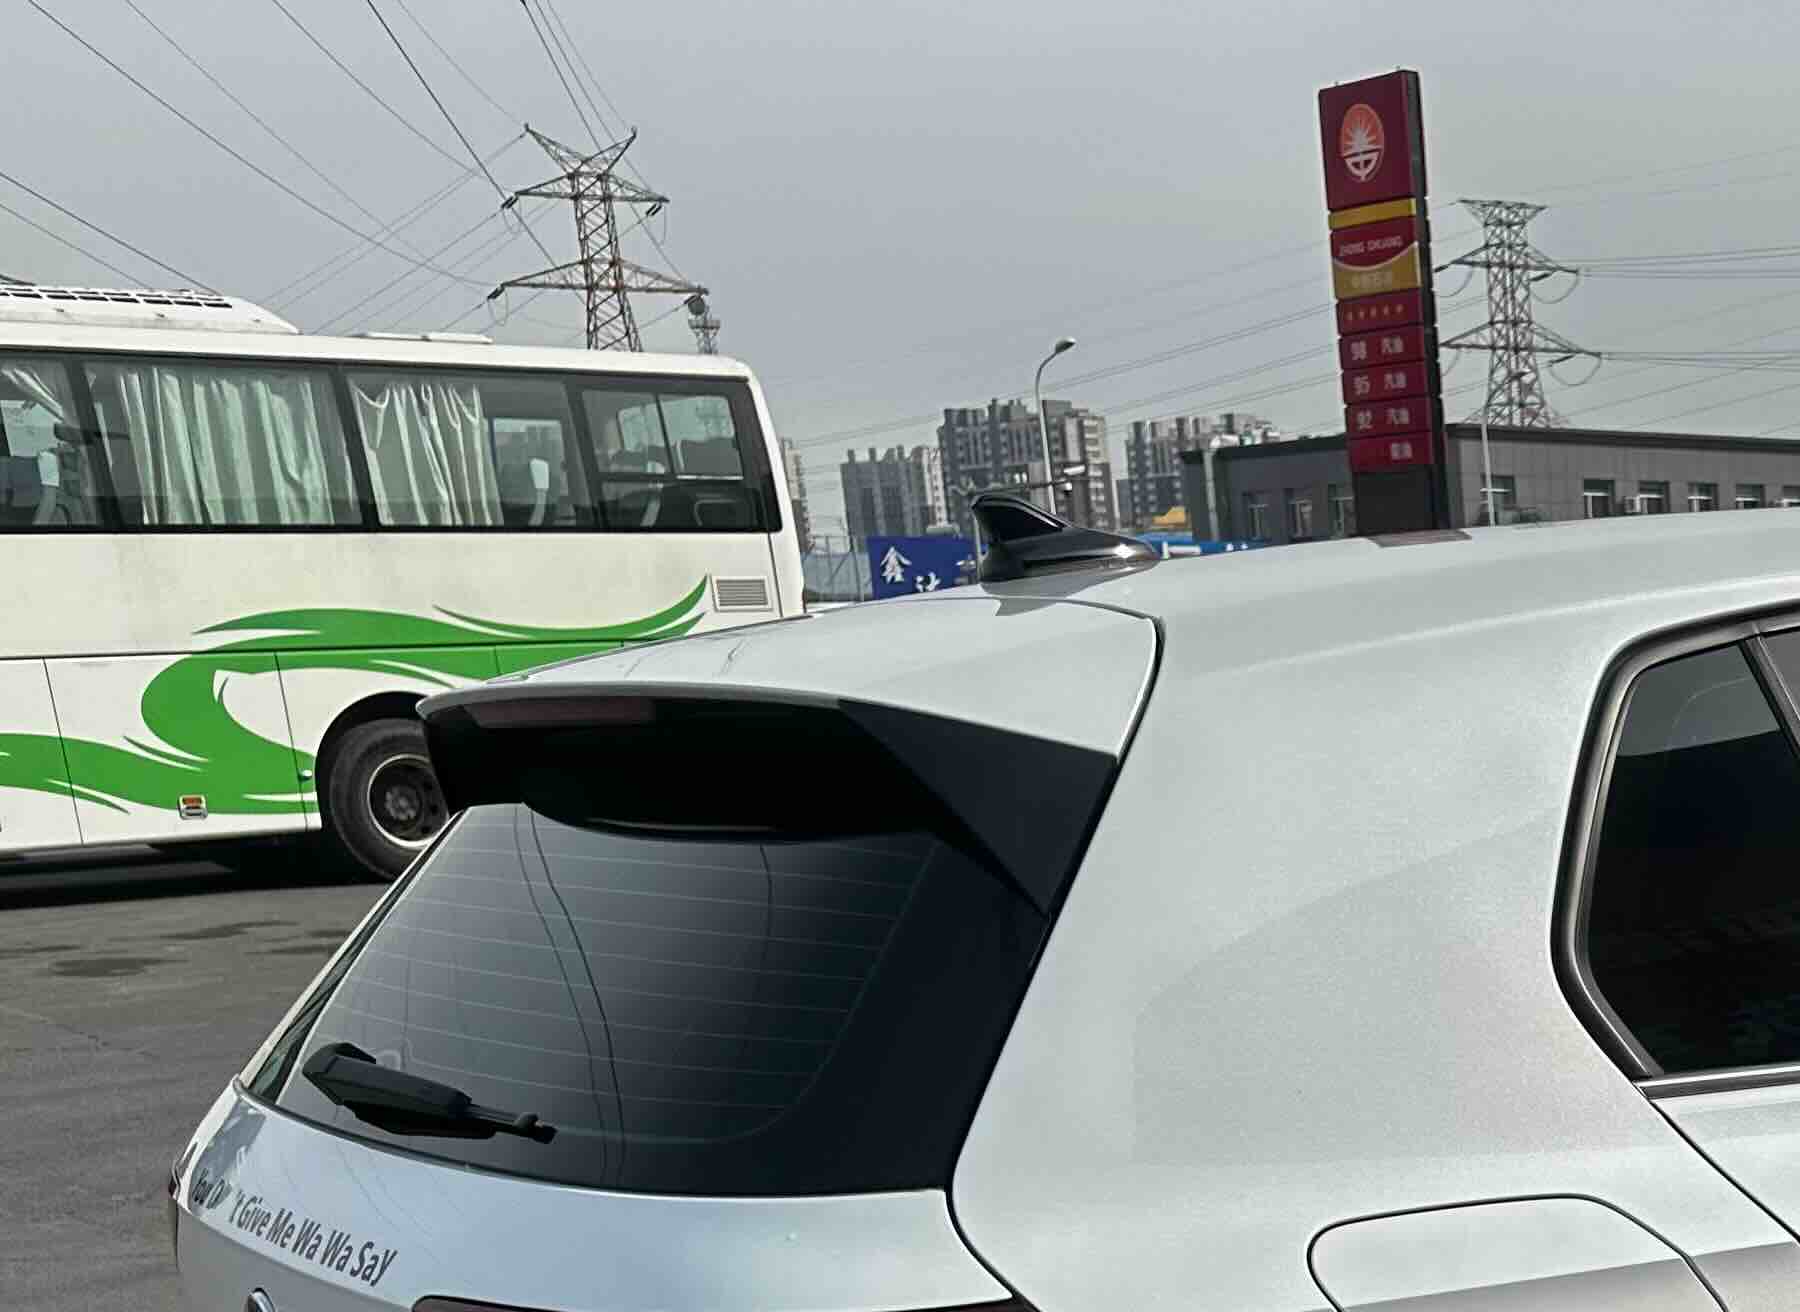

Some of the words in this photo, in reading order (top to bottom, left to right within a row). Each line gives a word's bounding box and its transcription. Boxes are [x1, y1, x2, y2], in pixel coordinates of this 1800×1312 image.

[236, 1195, 270, 1237] Give
[266, 1208, 296, 1249] Me
[292, 1218, 323, 1261] Wa
[320, 1230, 354, 1273] Wa
